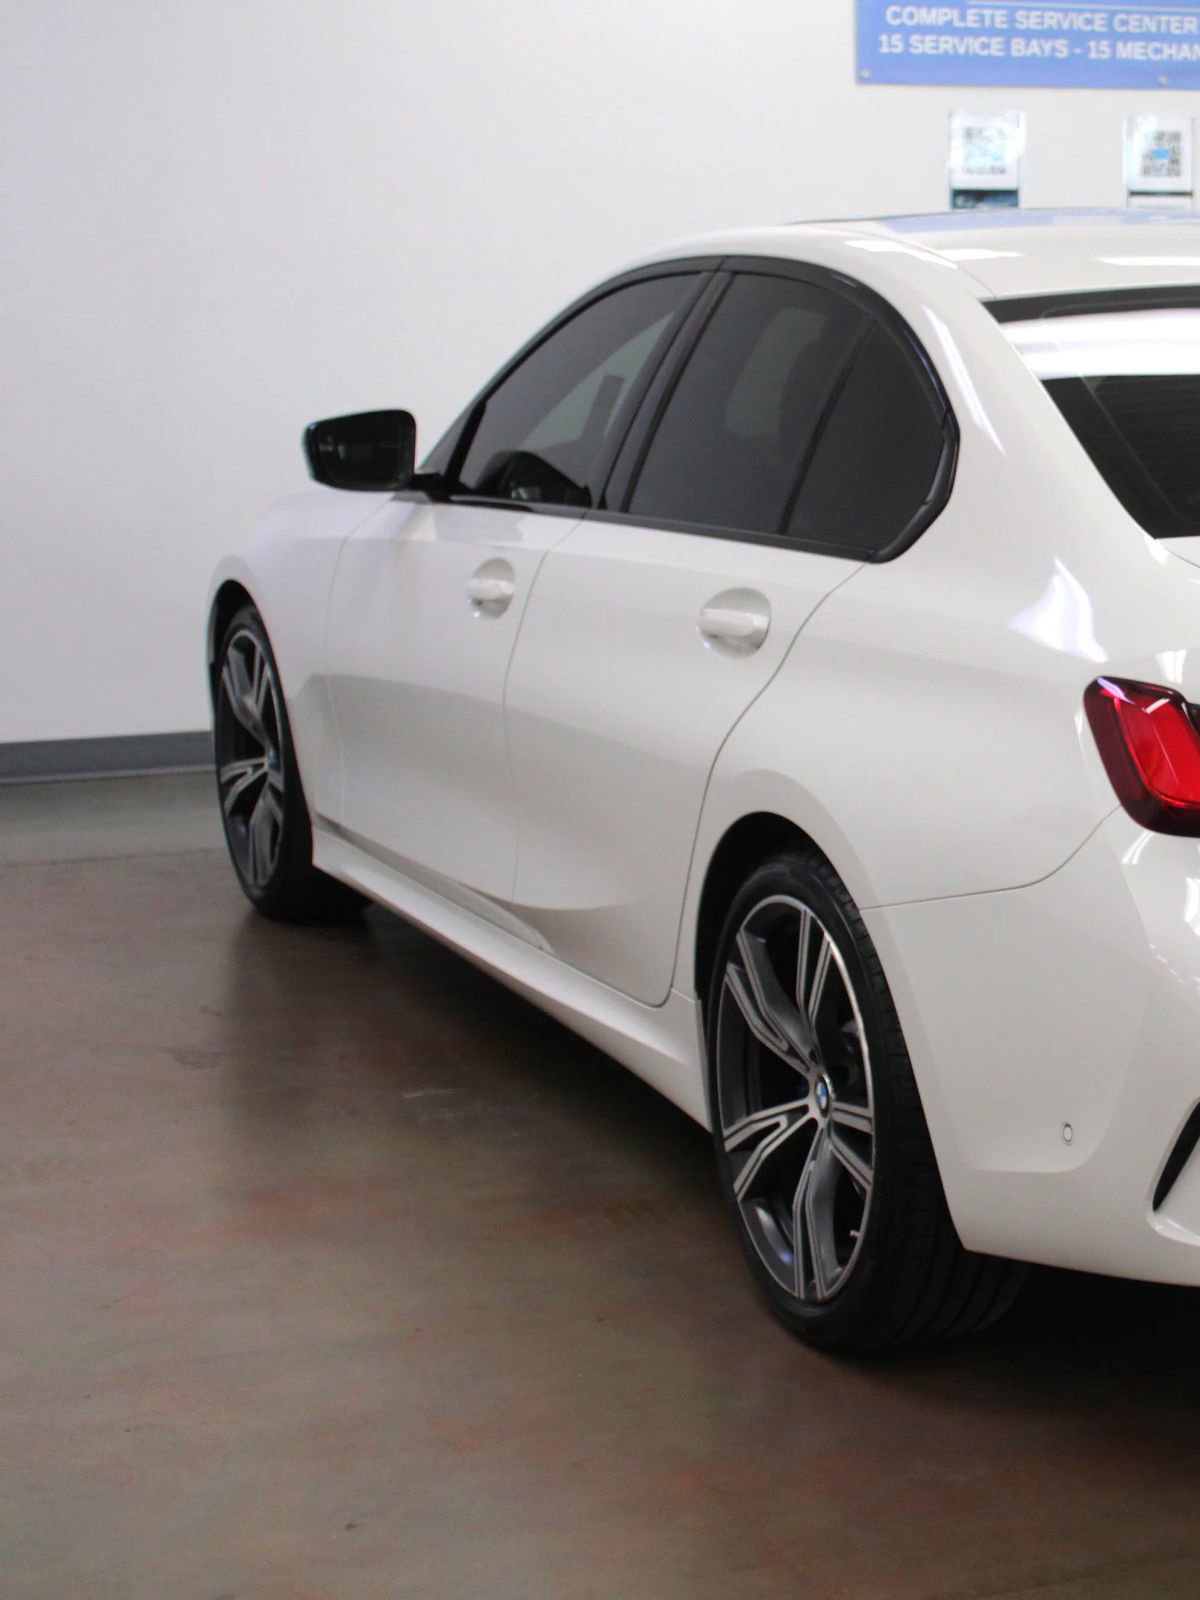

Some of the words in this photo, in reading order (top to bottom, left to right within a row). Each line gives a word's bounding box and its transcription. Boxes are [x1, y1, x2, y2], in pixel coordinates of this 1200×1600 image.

[886, 5, 1009, 30] COMPLETE
[1014, 9, 1109, 33] SERVICE
[1113, 13, 1198, 35] CENTER
[878, 33, 905, 54] 15
[909, 34, 1005, 57] SERVICE
[1010, 37, 1069, 59] BAYS
[1087, 40, 1112, 60] 15
